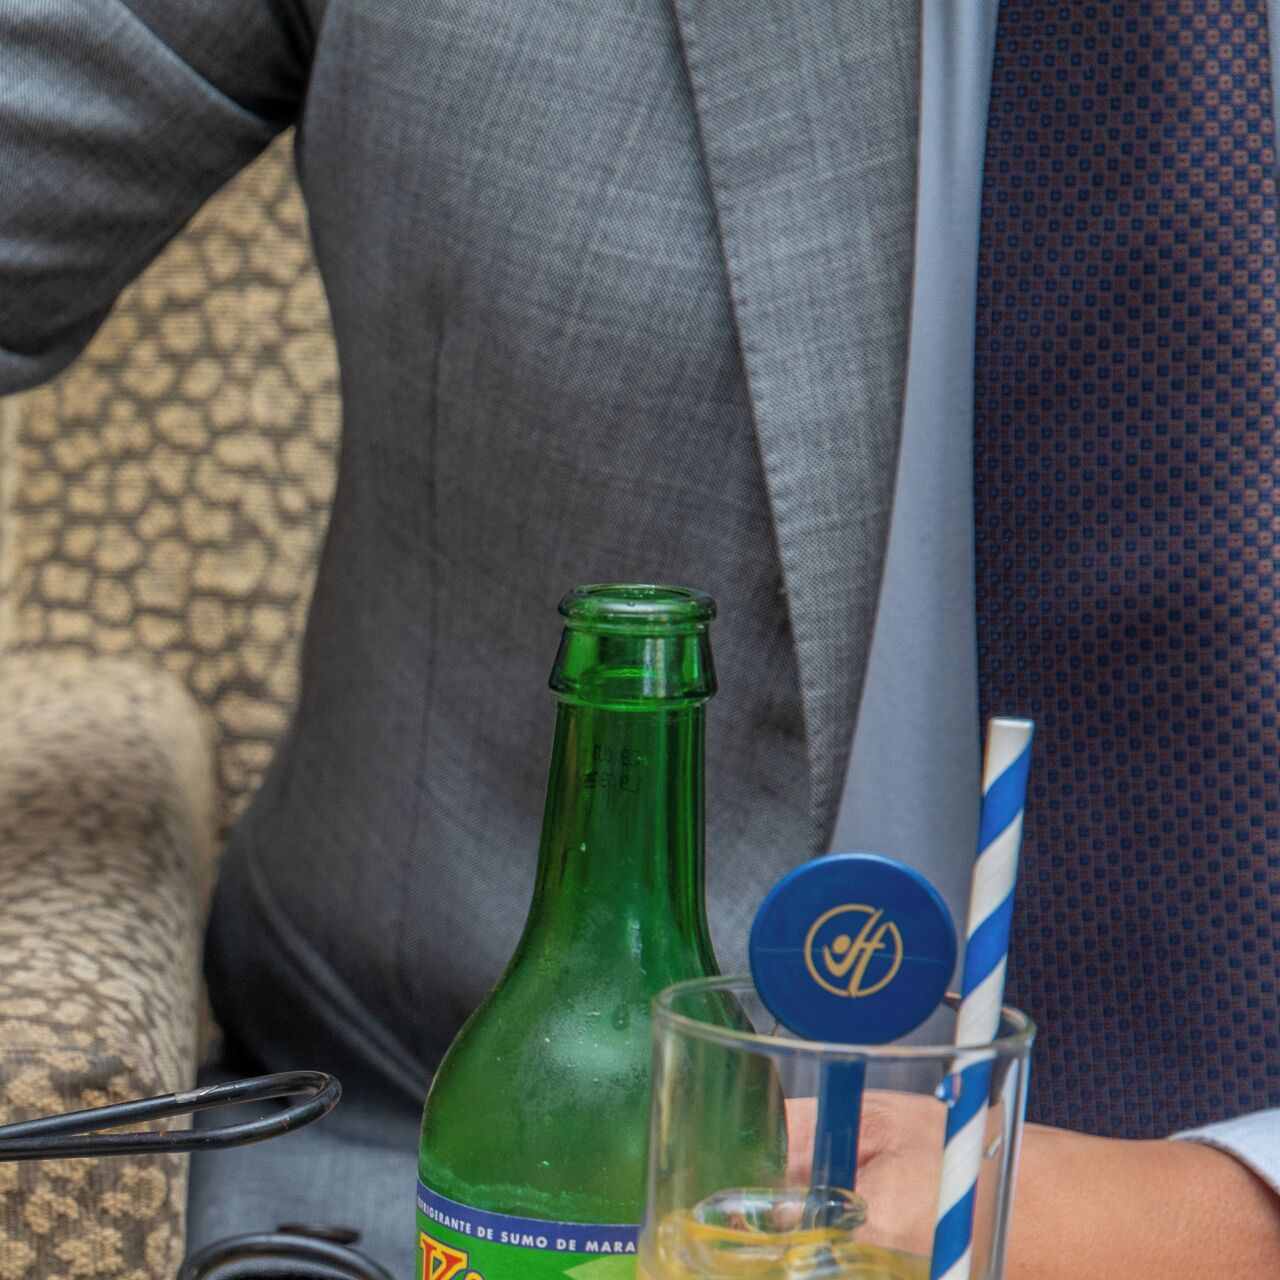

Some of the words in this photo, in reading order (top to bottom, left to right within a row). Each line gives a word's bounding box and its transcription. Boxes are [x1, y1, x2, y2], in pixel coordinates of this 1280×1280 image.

[477, 1226, 494, 1240] DE
[500, 1231, 548, 1250] SUMO
[556, 1238, 578, 1252] DE
